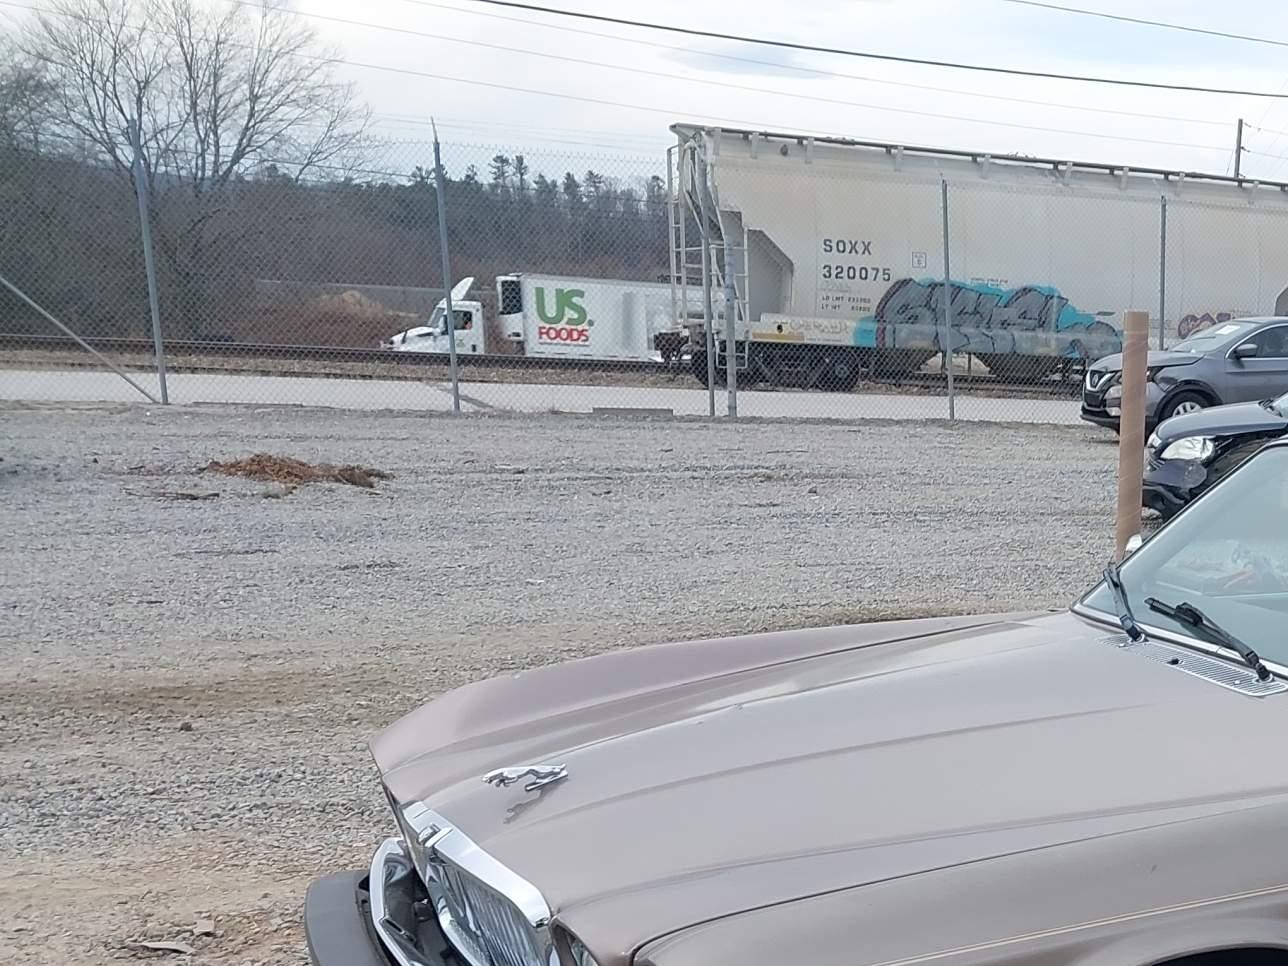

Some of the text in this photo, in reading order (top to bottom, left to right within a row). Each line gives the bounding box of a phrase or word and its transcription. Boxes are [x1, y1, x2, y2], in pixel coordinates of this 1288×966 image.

[823, 238, 872, 256] SOXX
[822, 265, 892, 282] 320075
[538, 326, 590, 343] FOODS
